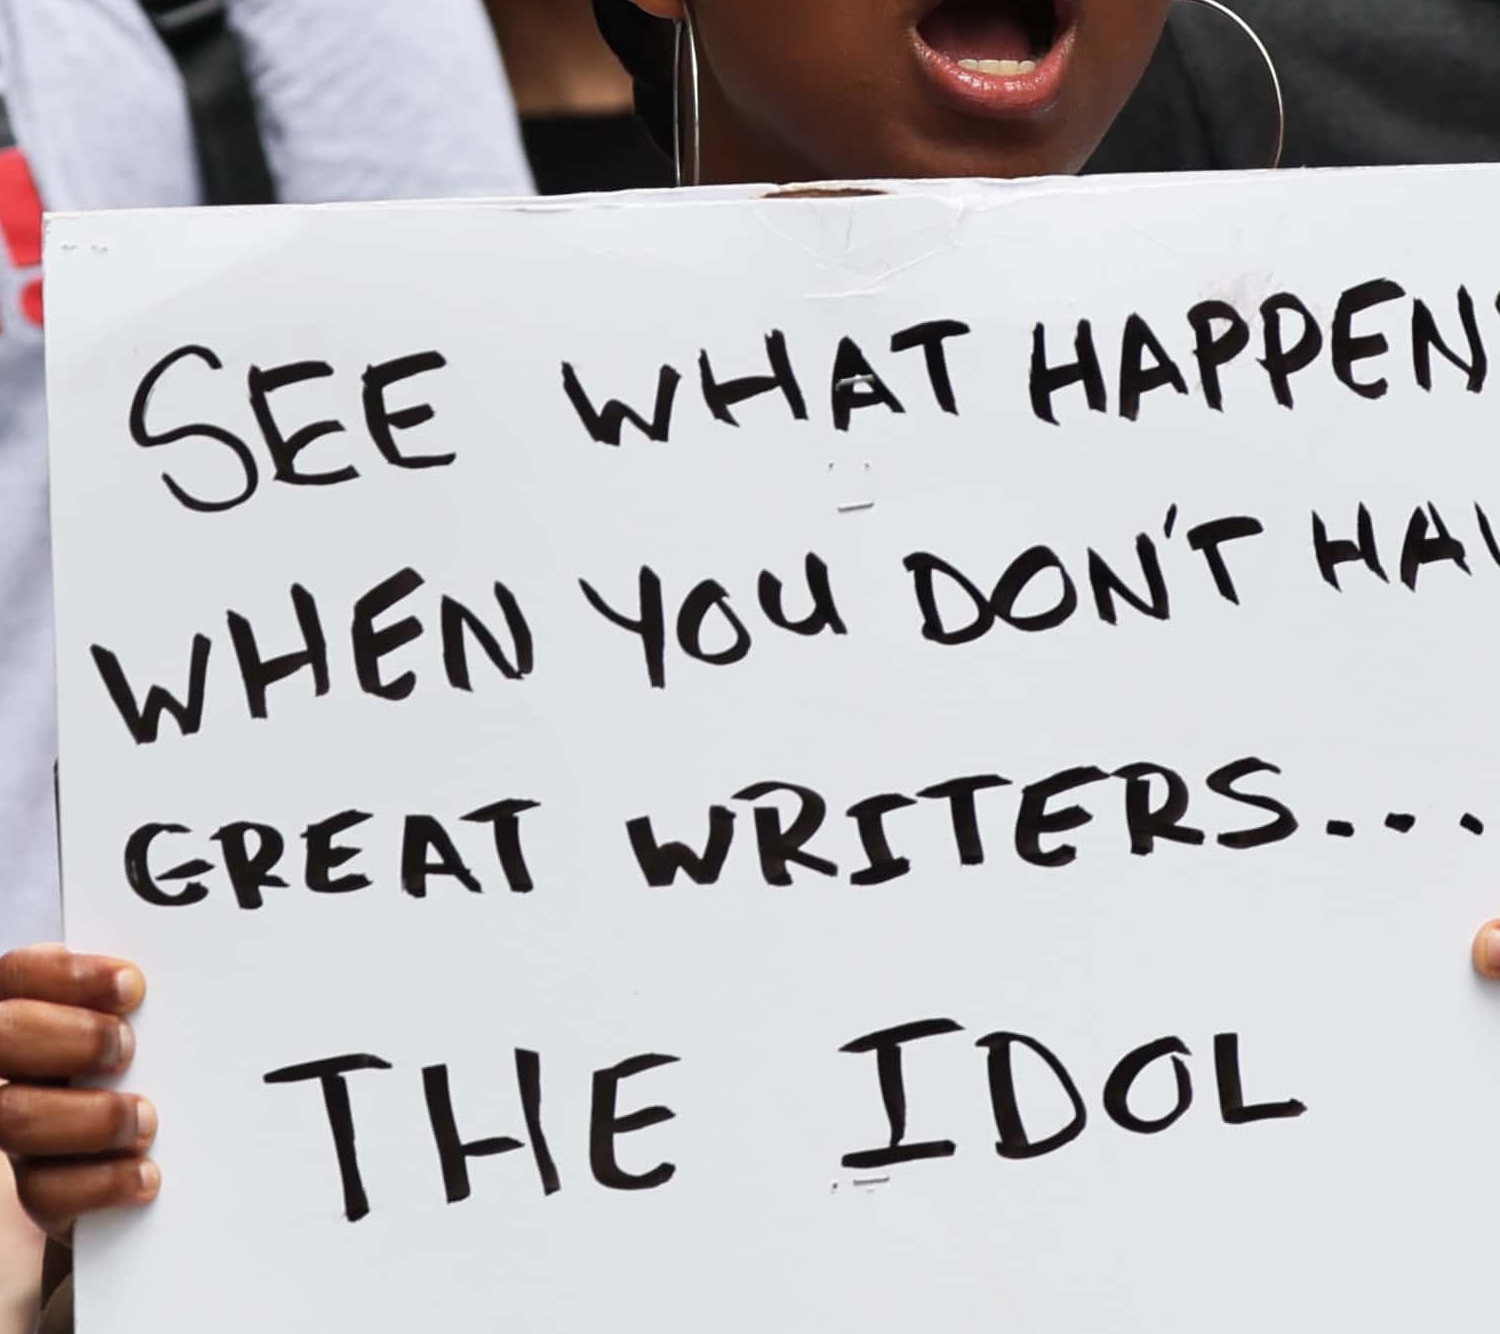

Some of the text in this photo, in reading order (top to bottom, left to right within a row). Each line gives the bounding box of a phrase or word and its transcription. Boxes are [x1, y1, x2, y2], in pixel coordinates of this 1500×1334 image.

[130, 342, 459, 515] SEE
[558, 317, 976, 451] WHAT
[90, 563, 535, 747] WHEN
[578, 549, 850, 693] YOU
[903, 502, 1265, 649] DON'T
[123, 754, 1489, 914] GREAT WRITERS...
[263, 1016, 1308, 1222] THE IDOL
